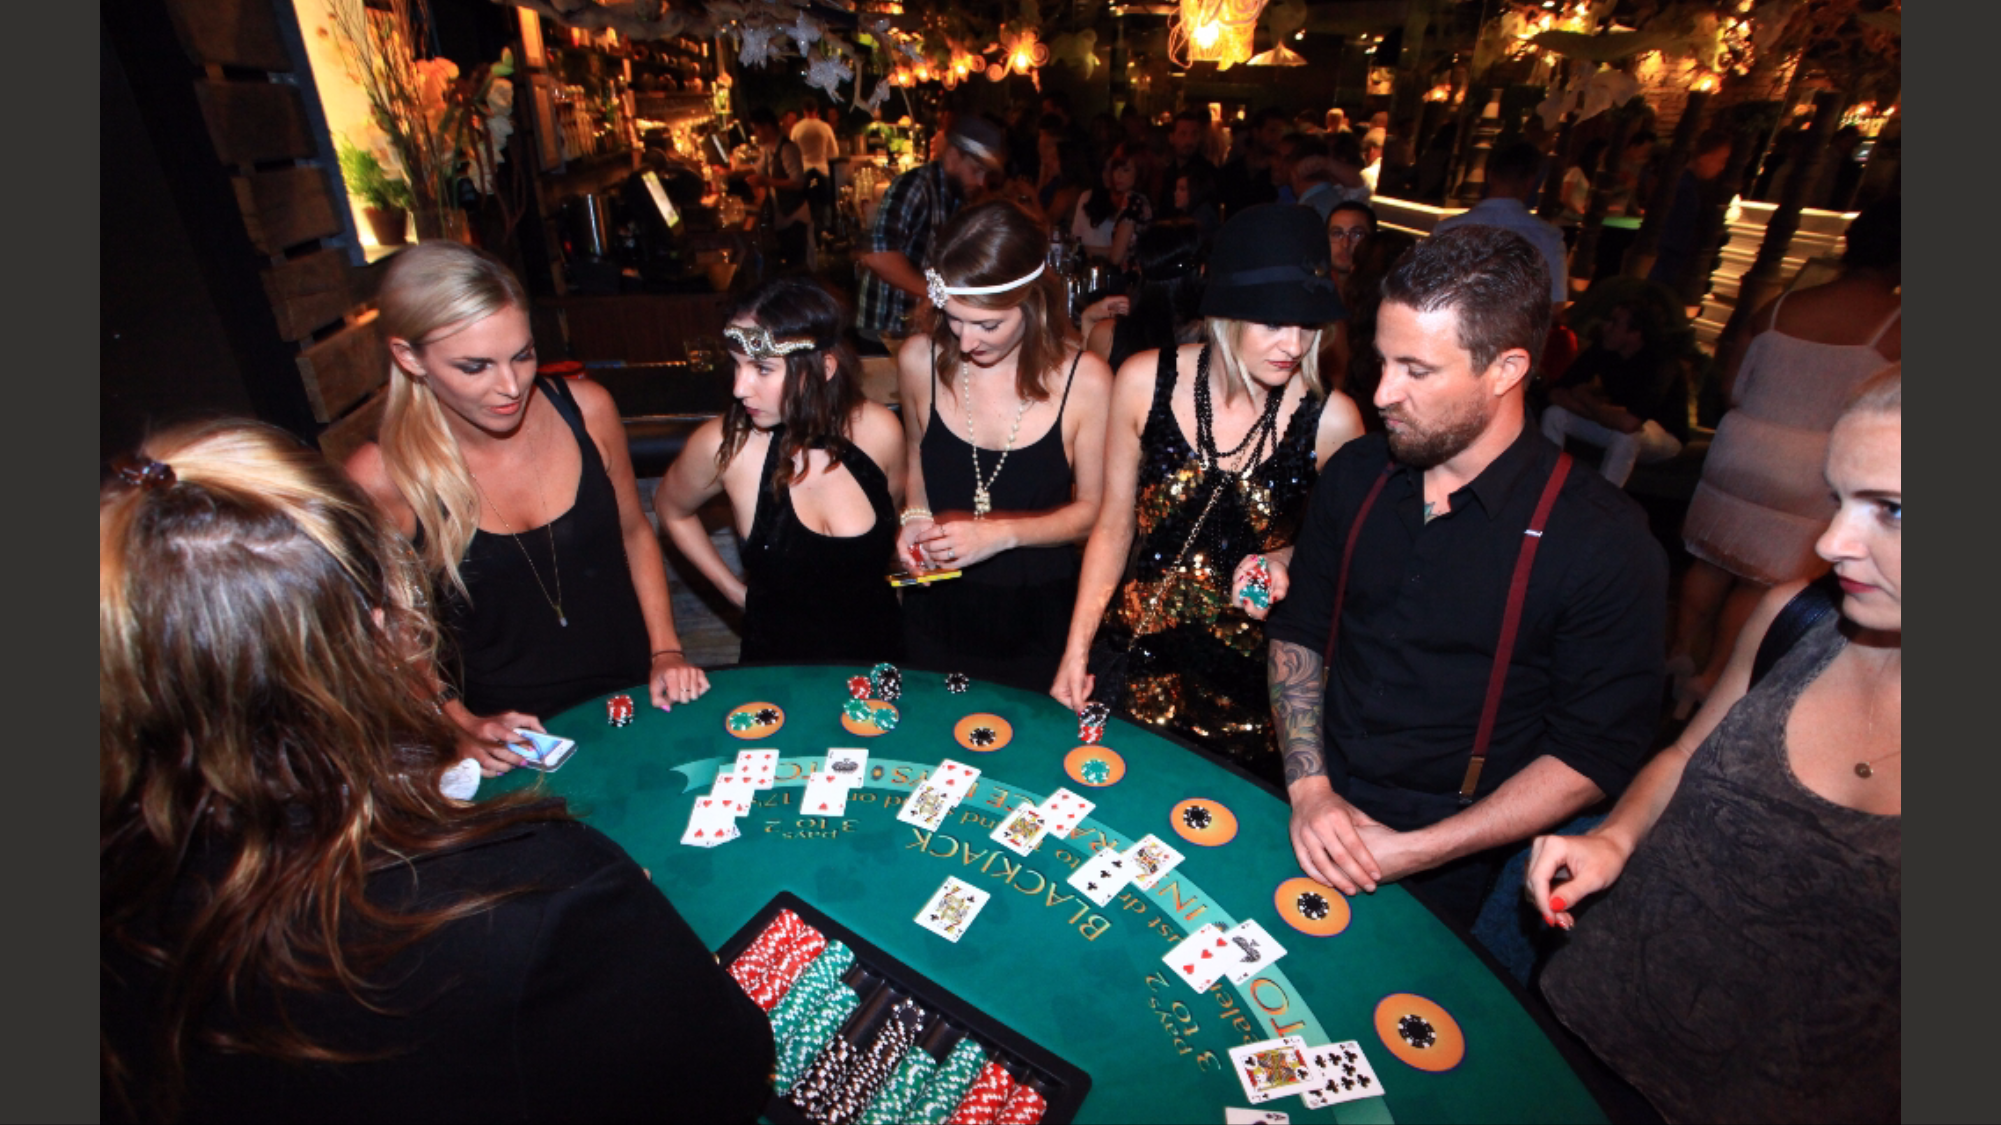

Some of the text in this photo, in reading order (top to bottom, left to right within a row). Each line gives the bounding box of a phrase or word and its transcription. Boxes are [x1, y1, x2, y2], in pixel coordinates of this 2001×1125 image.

[764, 816, 860, 833] 3 to 2
[905, 828, 1112, 942] BLACKJACK
[1055, 849, 1081, 868] to
[1145, 972, 1221, 1071] 3 to 2
[1149, 997, 1193, 1056] pays
